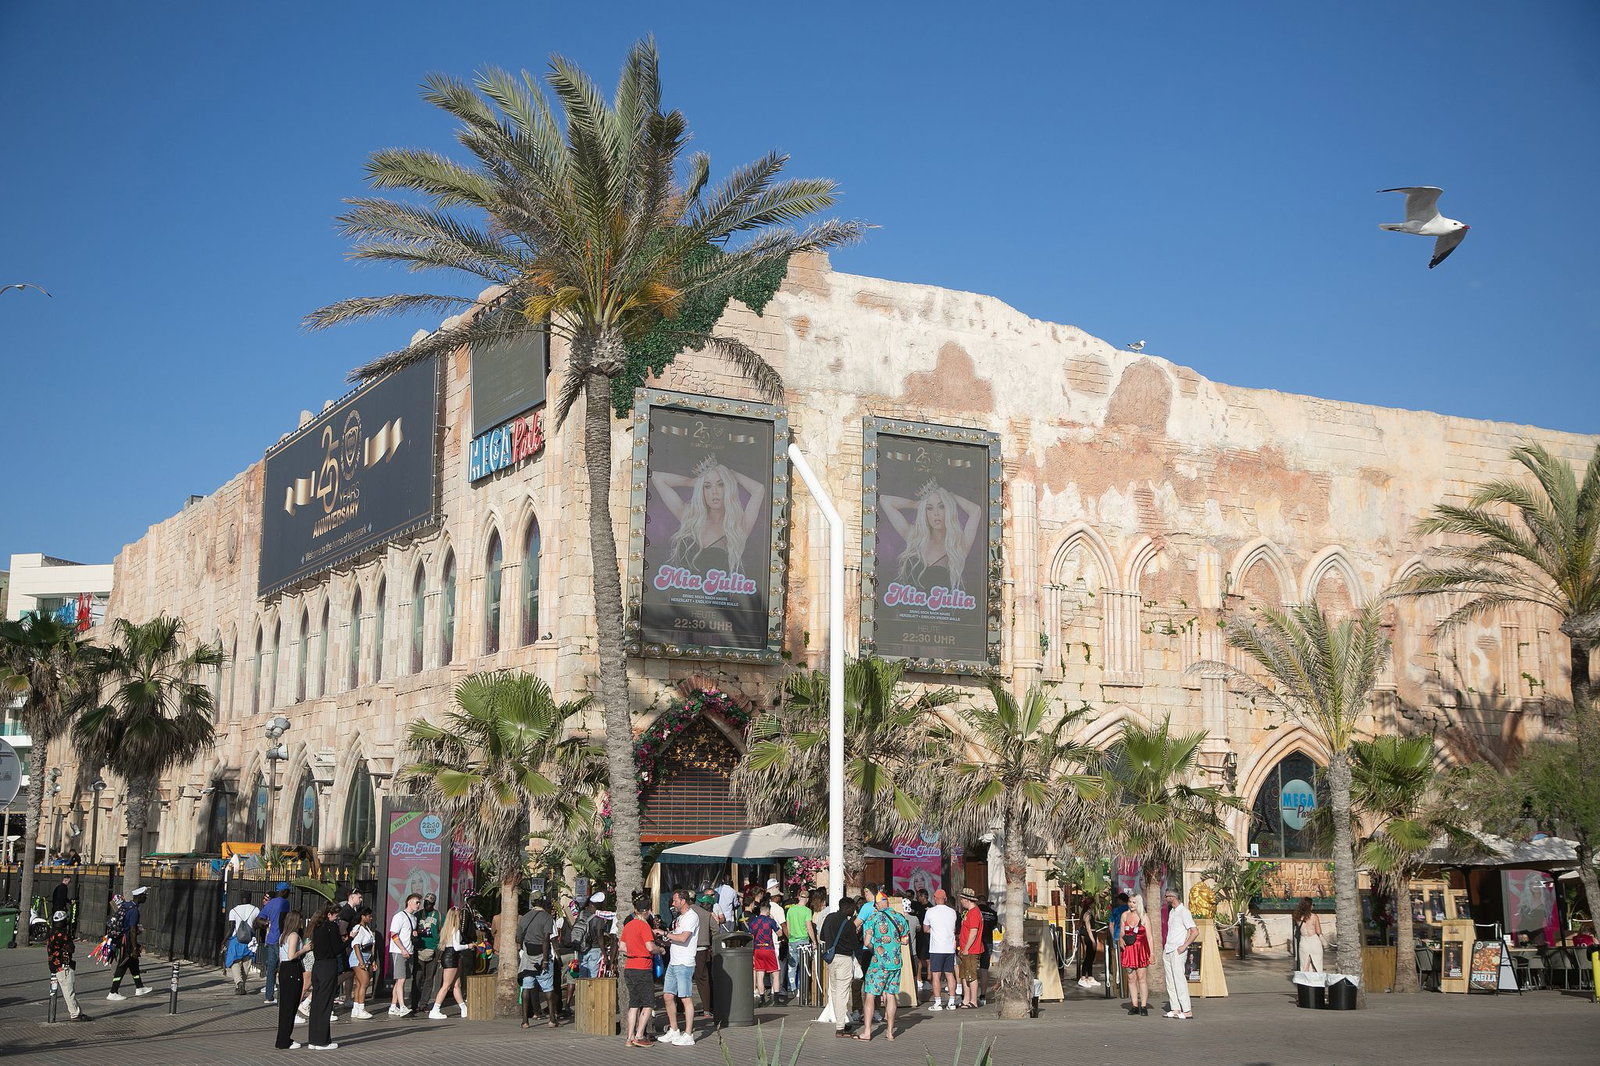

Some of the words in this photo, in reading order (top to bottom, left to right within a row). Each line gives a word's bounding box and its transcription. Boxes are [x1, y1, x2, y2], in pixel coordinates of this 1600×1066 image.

[469, 424, 512, 482] MEGA
[511, 411, 544, 464] Park
[317, 424, 339, 514] 25
[312, 501, 359, 539] ANNIVERSARY
[654, 565, 702, 591] Mia
[702, 569, 757, 595] Julia
[884, 582, 927, 606] Mia
[927, 586, 976, 611] Julia
[691, 610, 717, 619] HEUTE
[674, 618, 706, 630] 22:30
[709, 620, 733, 632] UHR
[902, 632, 931, 643] 22:30
[934, 634, 956, 645] UHR
[1283, 793, 1315, 808] MEGA
[391, 841, 415, 856] Mia
[415, 841, 441, 857] Julia
[1285, 864, 1320, 880] MEGA
[1472, 973, 1496, 982] PAELLA
